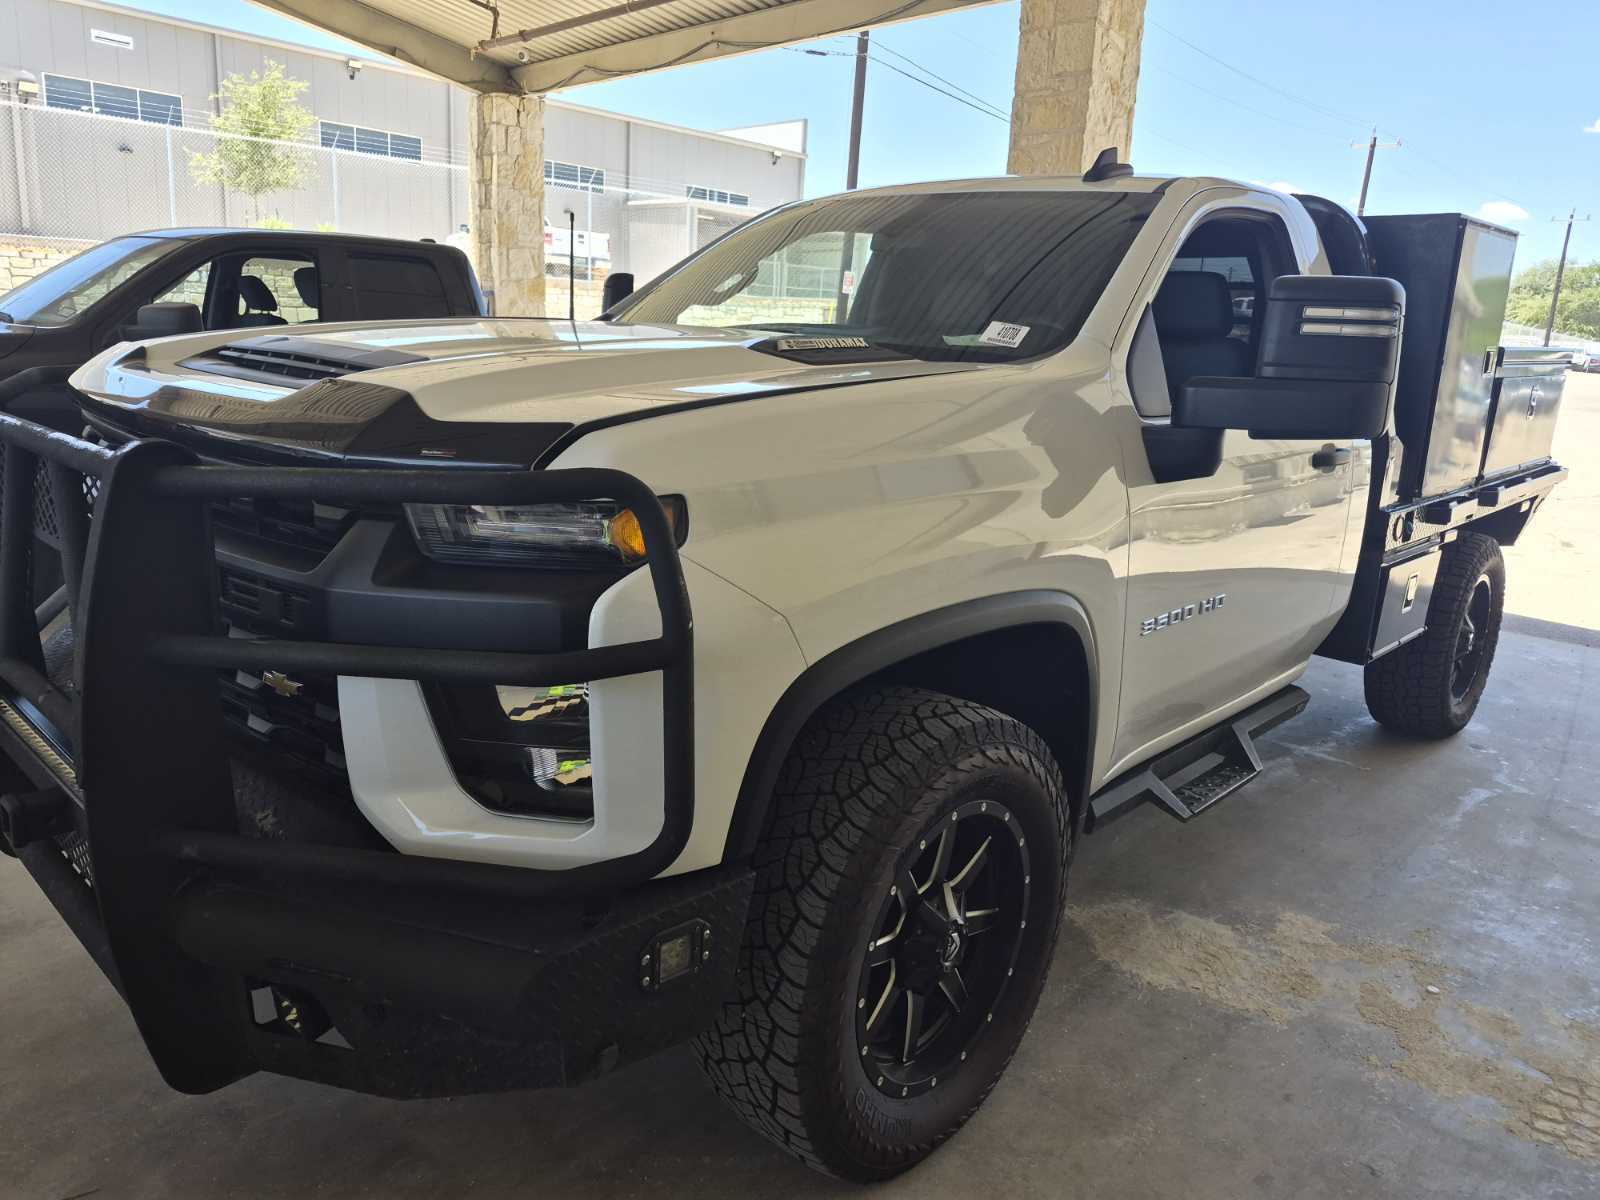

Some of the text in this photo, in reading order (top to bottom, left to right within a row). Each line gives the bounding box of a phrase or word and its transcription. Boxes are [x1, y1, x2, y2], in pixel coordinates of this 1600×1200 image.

[815, 337, 869, 349] DURAMAX
[1140, 593, 1226, 636] 3500 HD
